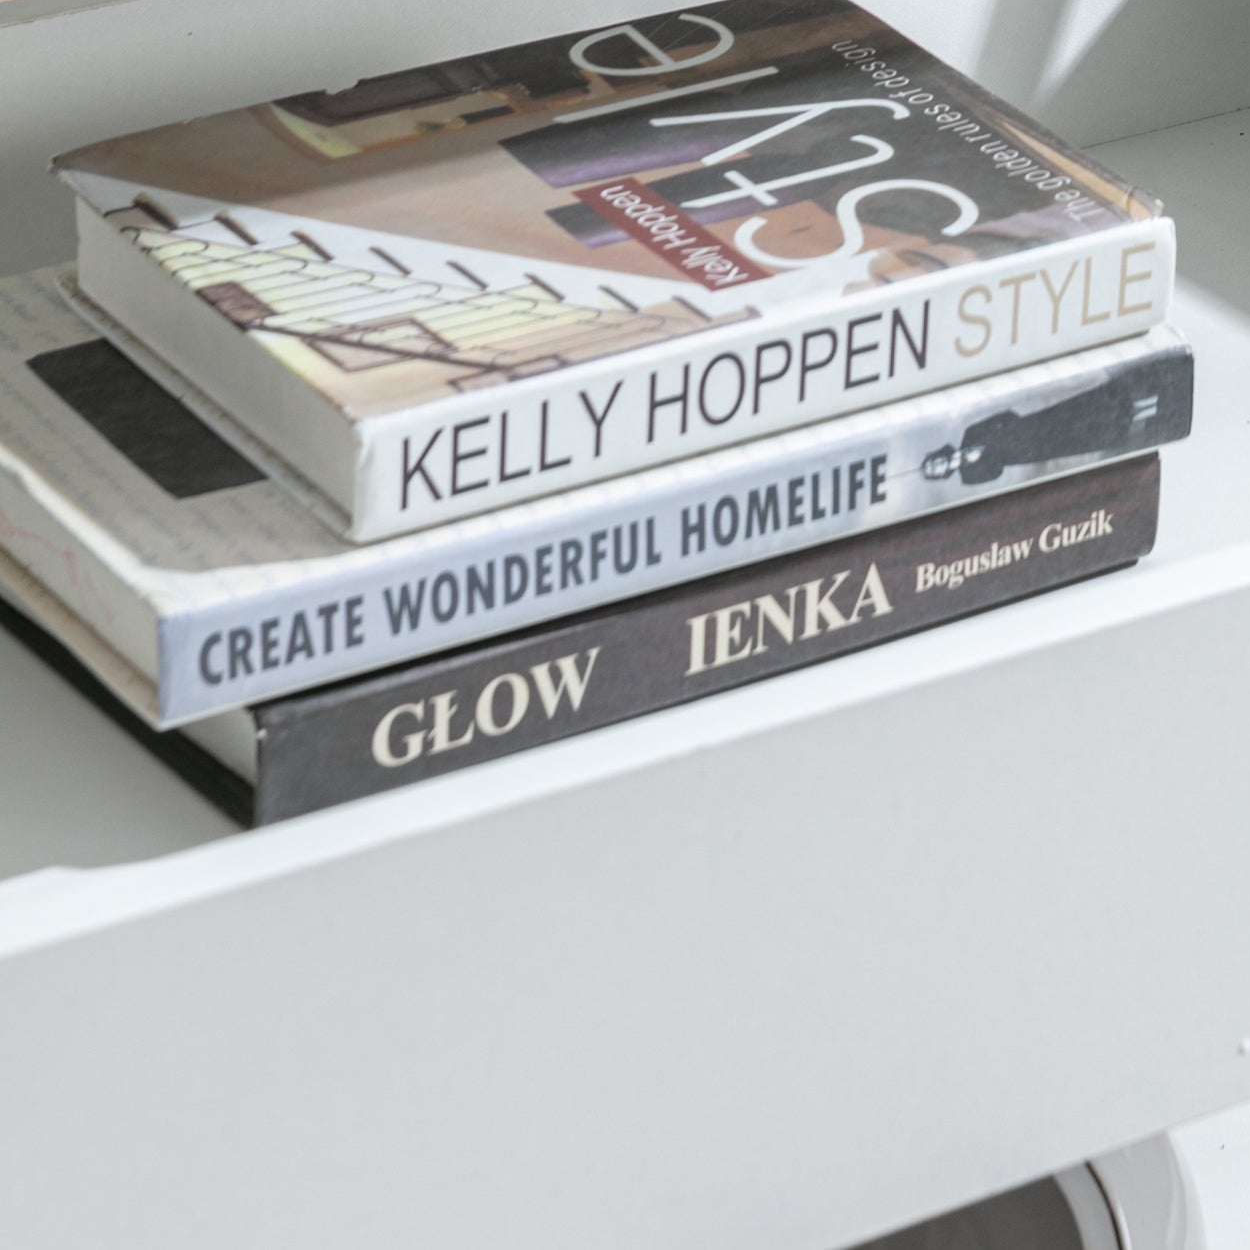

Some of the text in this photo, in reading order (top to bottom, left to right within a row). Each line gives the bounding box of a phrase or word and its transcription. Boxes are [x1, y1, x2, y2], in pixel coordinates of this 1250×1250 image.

[600, 184, 749, 286] Kelly Hoppen
[831, 39, 1106, 222] The golden rules of design
[400, 380, 623, 511] KELLY
[646, 298, 932, 444] HOPPEN
[953, 241, 1157, 358] STYLE
[199, 453, 888, 686] CREATE WONDERFUL HOMELIFE
[371, 646, 601, 769] GŁOW
[684, 561, 893, 677] IENKA
[1038, 508, 1115, 554] Guzik
